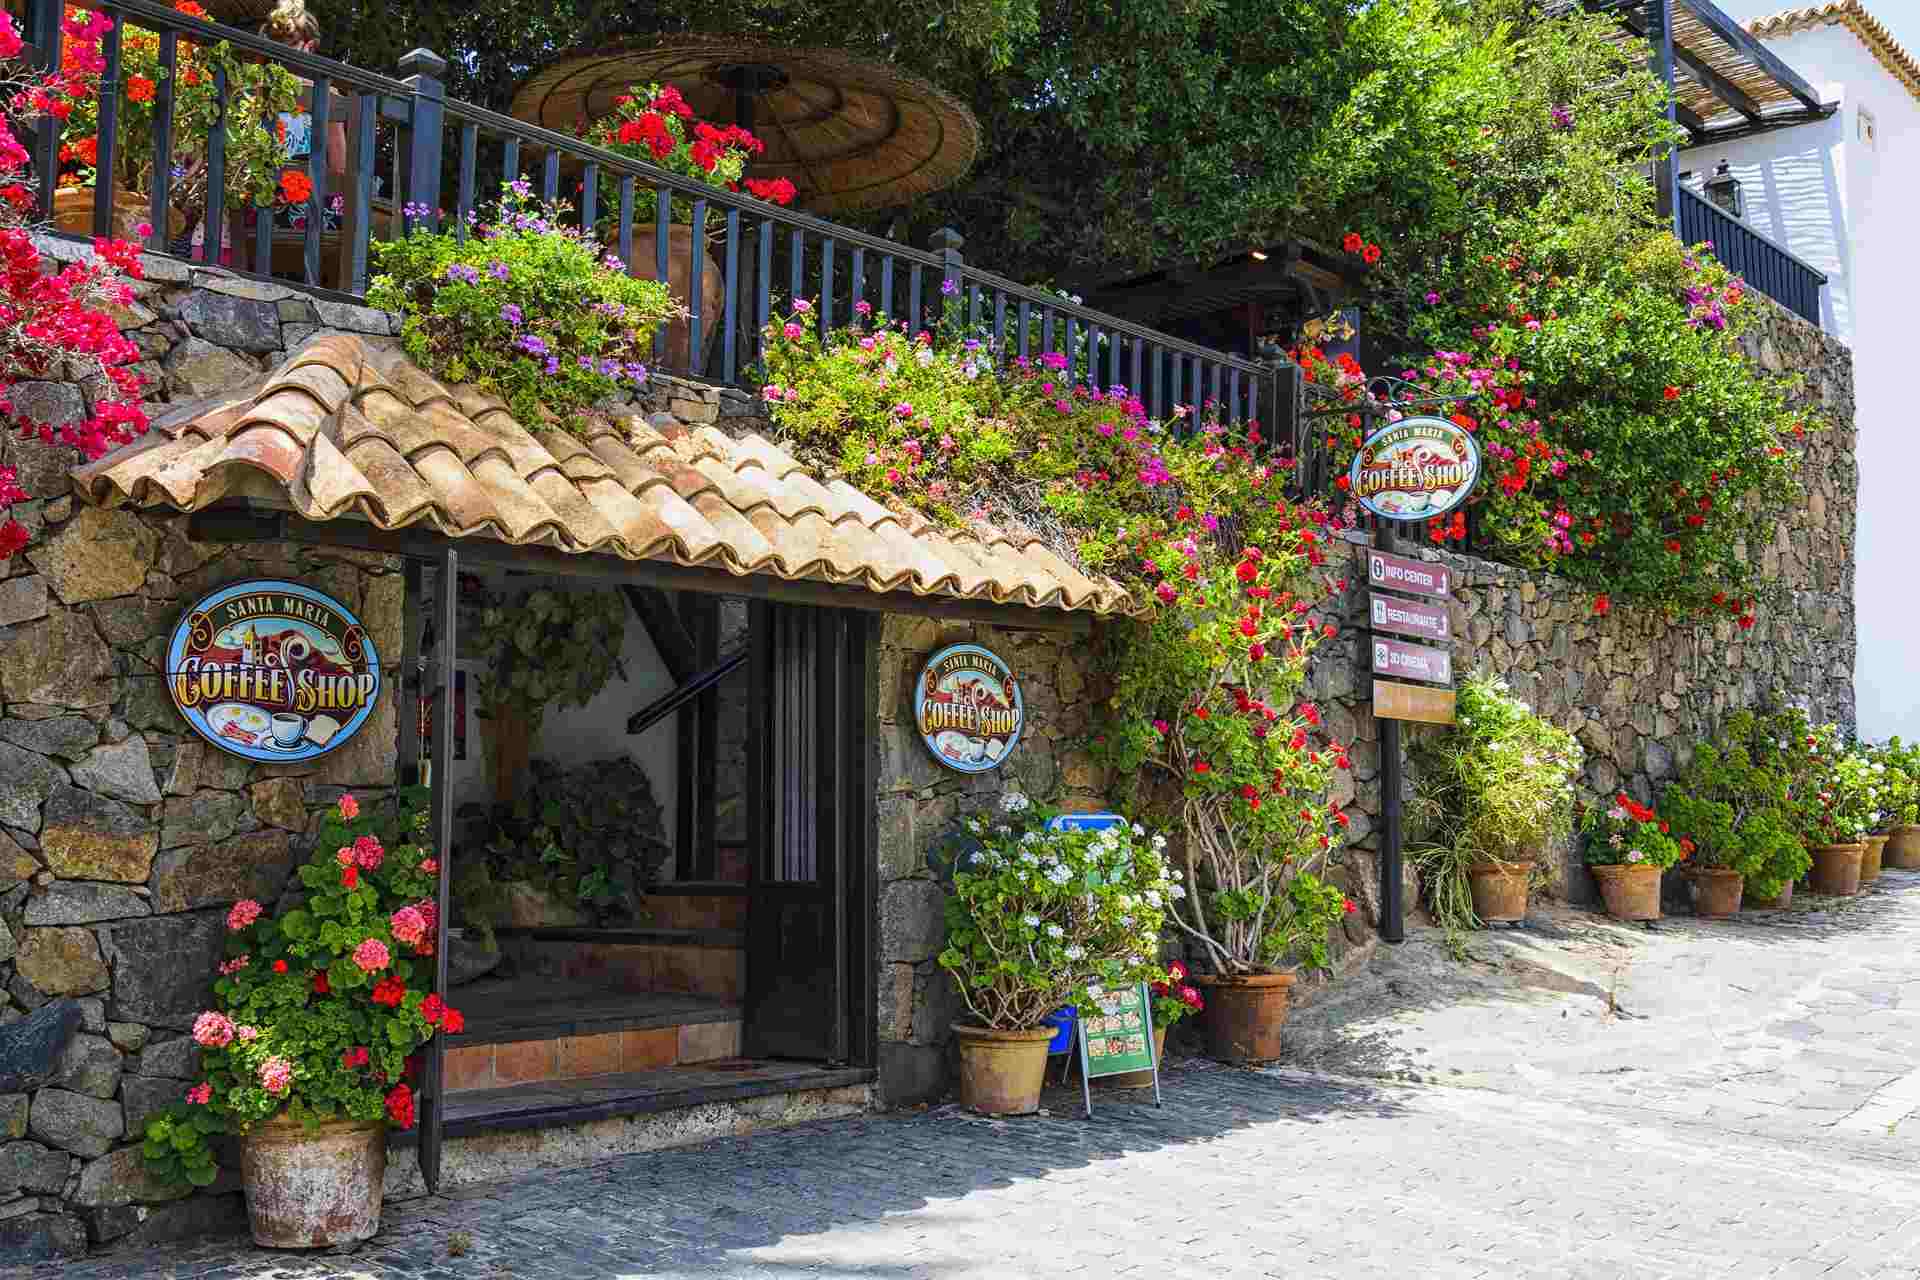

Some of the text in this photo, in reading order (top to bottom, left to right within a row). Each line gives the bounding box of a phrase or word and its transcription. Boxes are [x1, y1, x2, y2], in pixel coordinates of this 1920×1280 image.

[1382, 426, 1442, 446] SANTA MARIA
[1356, 462, 1474, 496] COFFEE SHOP
[1385, 565, 1433, 586] INFO CENTER
[227, 597, 328, 625] SANTA MARIA
[944, 655, 997, 676] SANTA MARIA
[176, 656, 374, 711] COFFEE SHOP
[920, 701, 1020, 736] COFFEE SHOP
